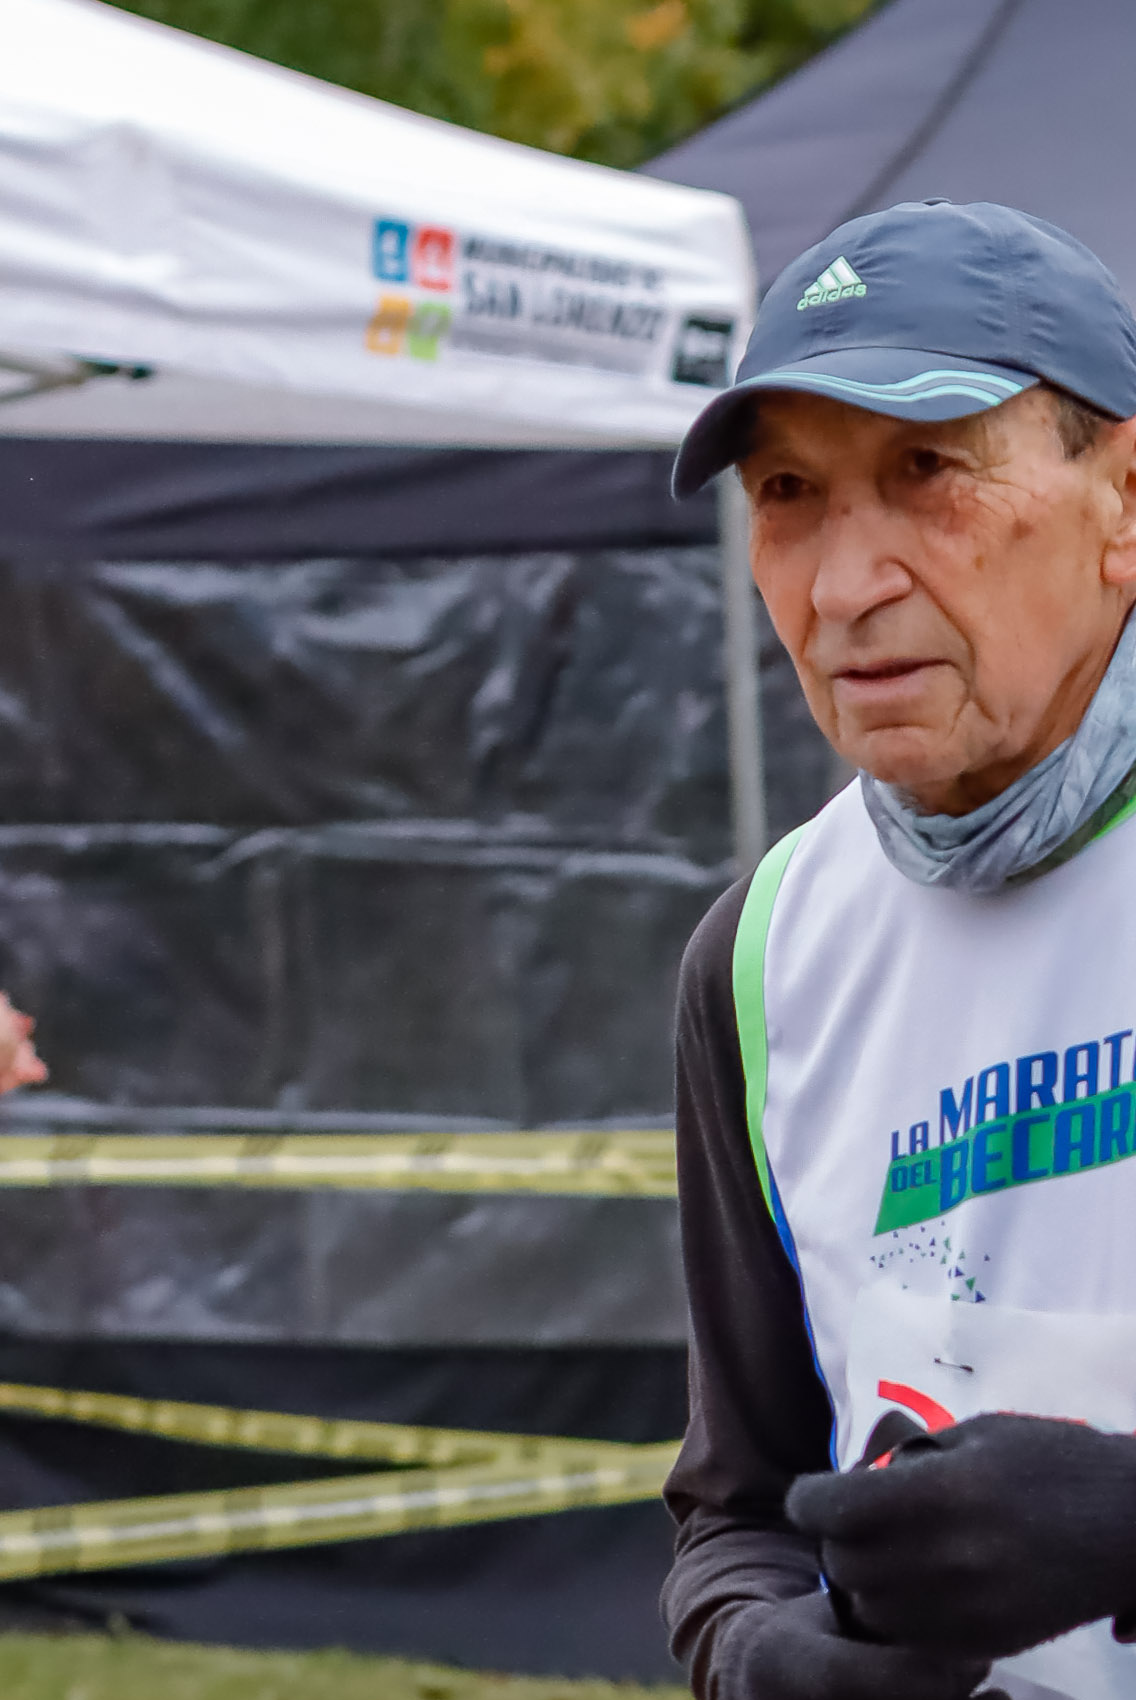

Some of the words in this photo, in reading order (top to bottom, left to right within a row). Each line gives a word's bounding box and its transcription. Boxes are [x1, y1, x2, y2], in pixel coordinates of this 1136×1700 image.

[797, 284, 867, 311] adidas
[891, 1121, 929, 1160] LA
[891, 1160, 937, 1193] DEL
